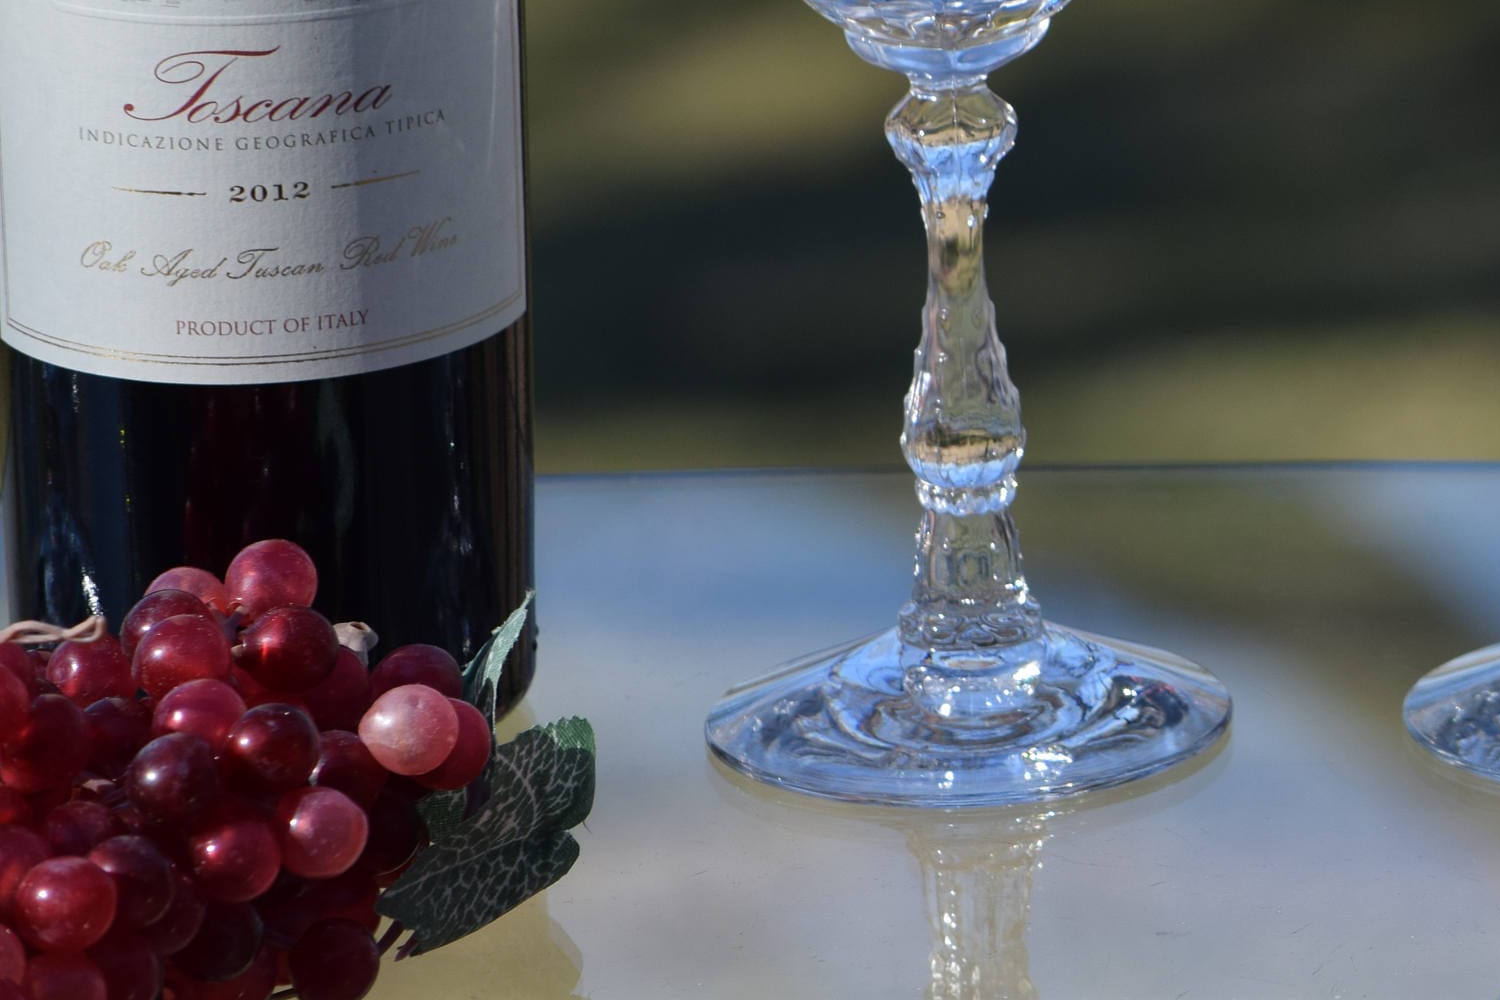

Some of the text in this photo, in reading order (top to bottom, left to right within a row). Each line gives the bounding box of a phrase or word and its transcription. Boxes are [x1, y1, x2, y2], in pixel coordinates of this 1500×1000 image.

[124, 45, 394, 125] Toscana
[79, 110, 446, 151] INDICAZIONE GEOGRAFICA TIPICA
[229, 181, 312, 203] 2012
[80, 216, 460, 287] Oak Aged Tuscan Red Wine
[175, 309, 370, 337] PRODUCT OF ITALY
